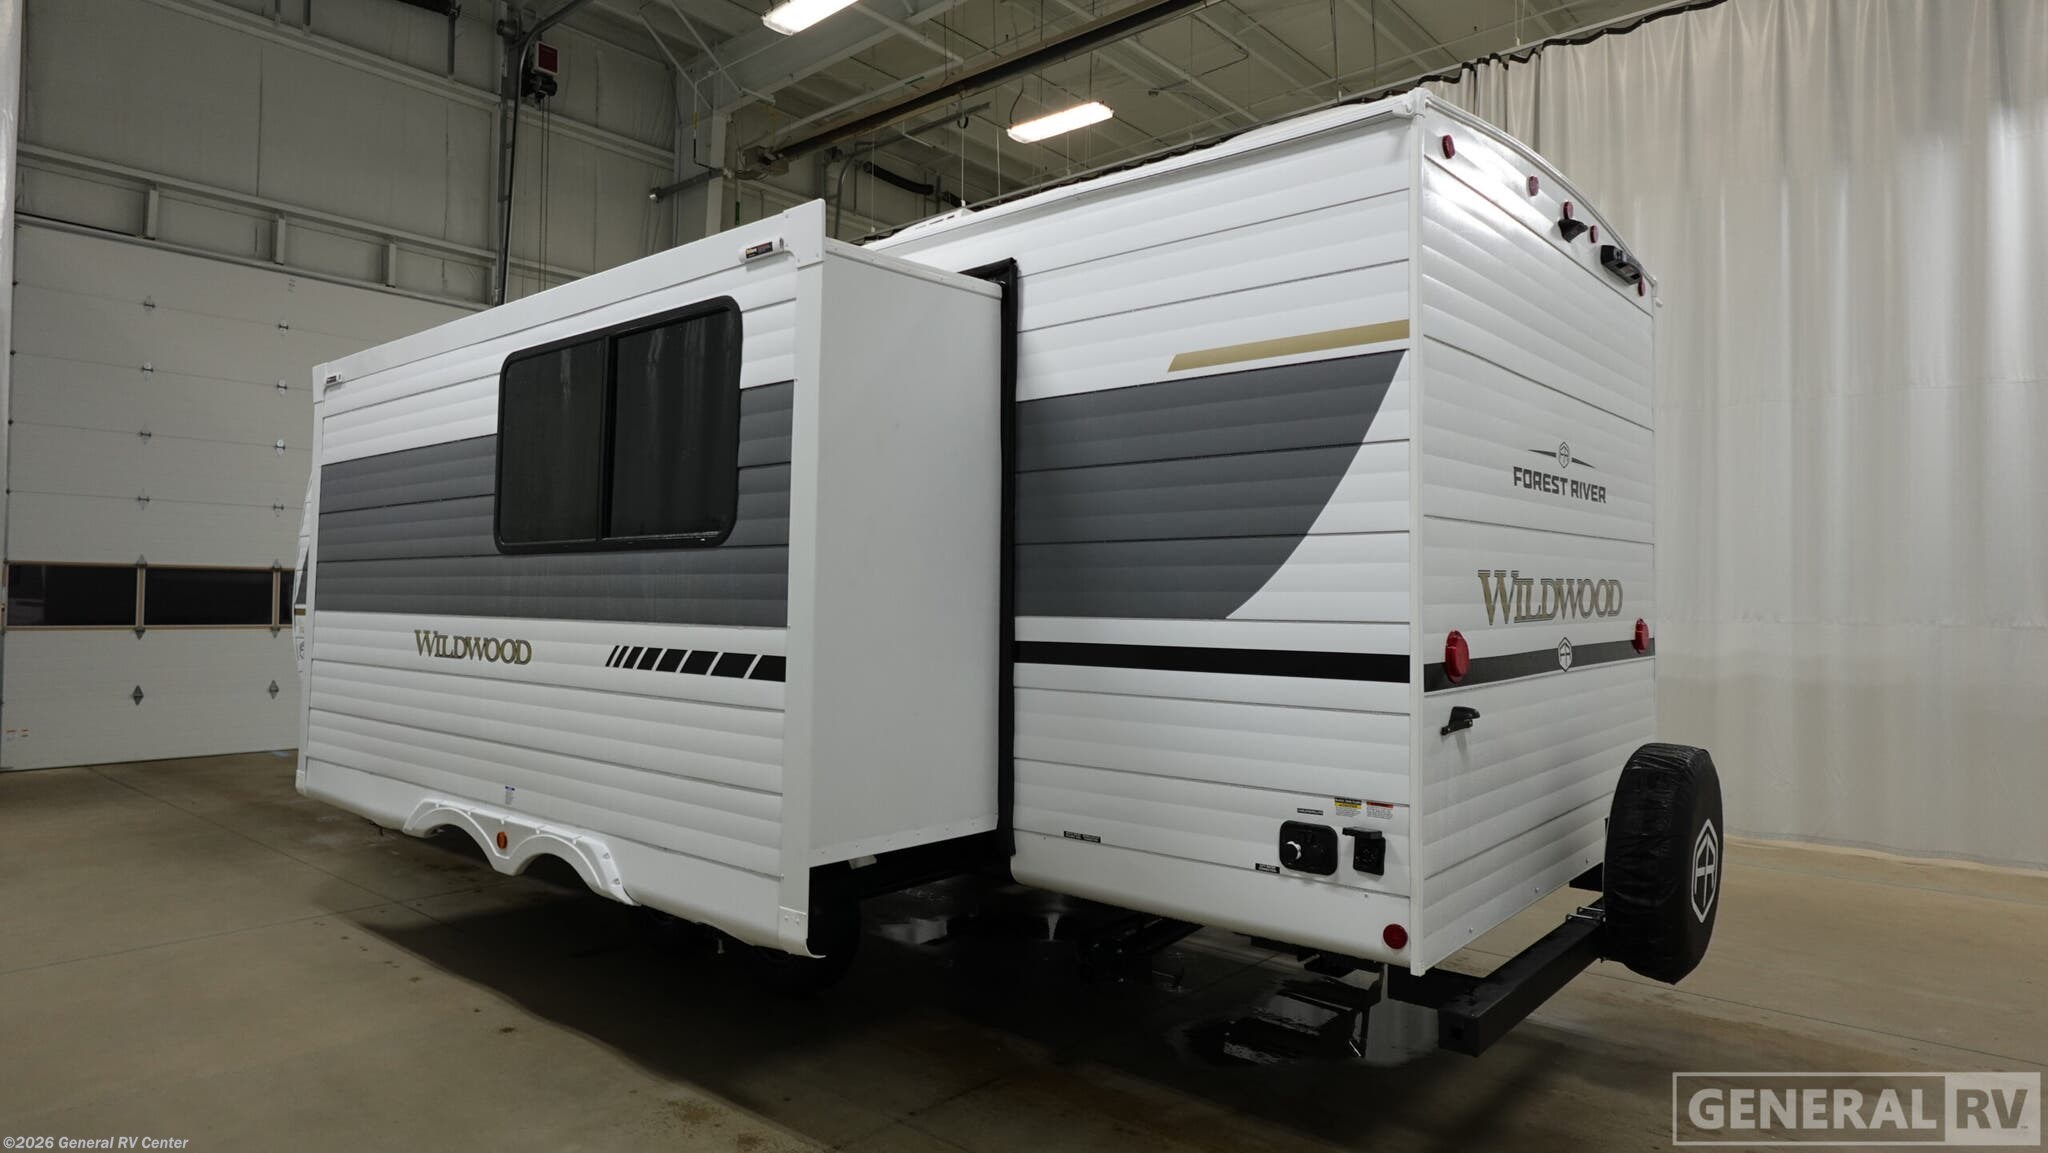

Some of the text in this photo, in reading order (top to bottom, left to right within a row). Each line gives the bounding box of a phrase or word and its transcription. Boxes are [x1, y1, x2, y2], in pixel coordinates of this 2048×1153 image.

[1513, 466, 1607, 503] FOREST RIVER
[1477, 569, 1624, 626] WILDWOOD
[414, 629, 532, 665] WILDWOOD
